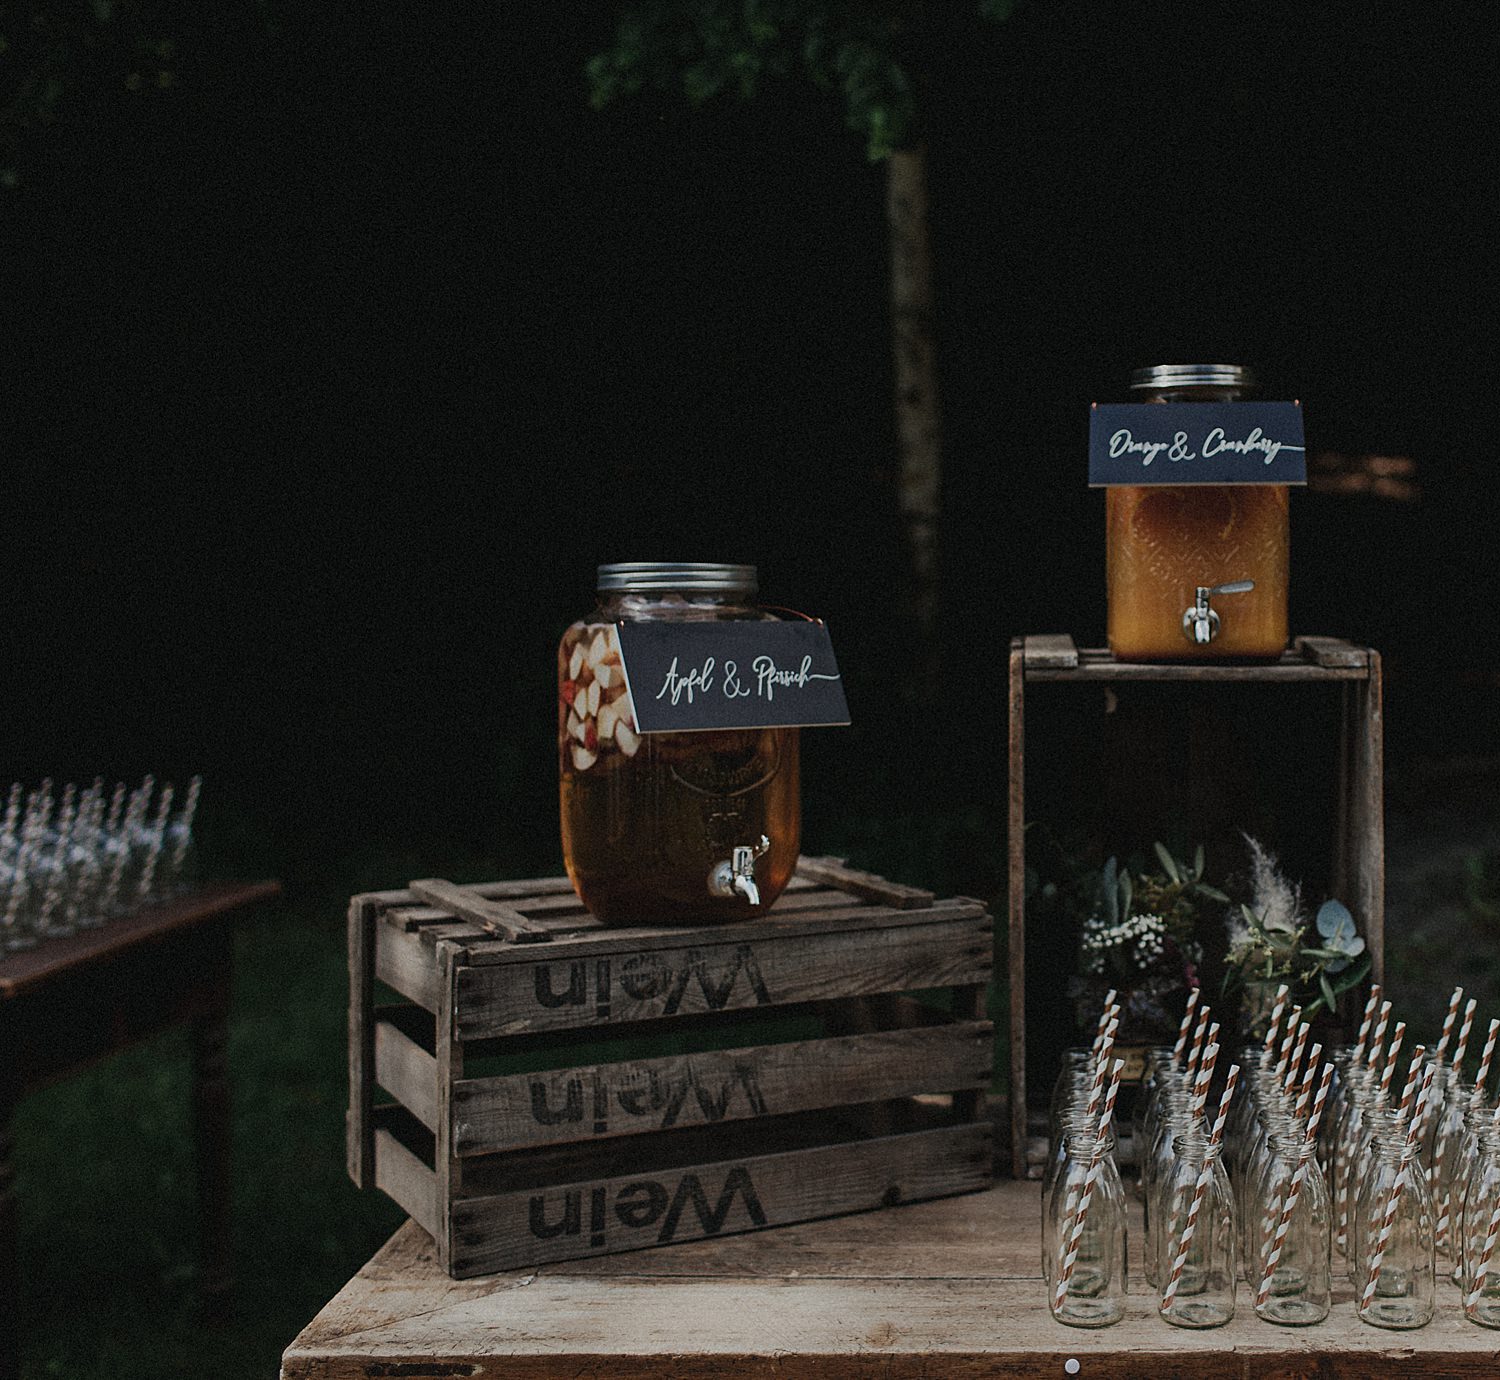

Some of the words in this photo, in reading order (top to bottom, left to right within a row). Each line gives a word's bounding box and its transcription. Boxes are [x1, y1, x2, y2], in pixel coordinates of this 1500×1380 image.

[1109, 429, 1169, 466] Orange
[1168, 431, 1197, 462] &
[1202, 427, 1306, 465] Cranberry
[656, 656, 716, 706] Apfel
[723, 660, 751, 699] &
[752, 655, 841, 701] Pfirsich
[534, 946, 772, 1018] Wein
[529, 1060, 768, 1134] Wein
[528, 1166, 767, 1247] Wein
